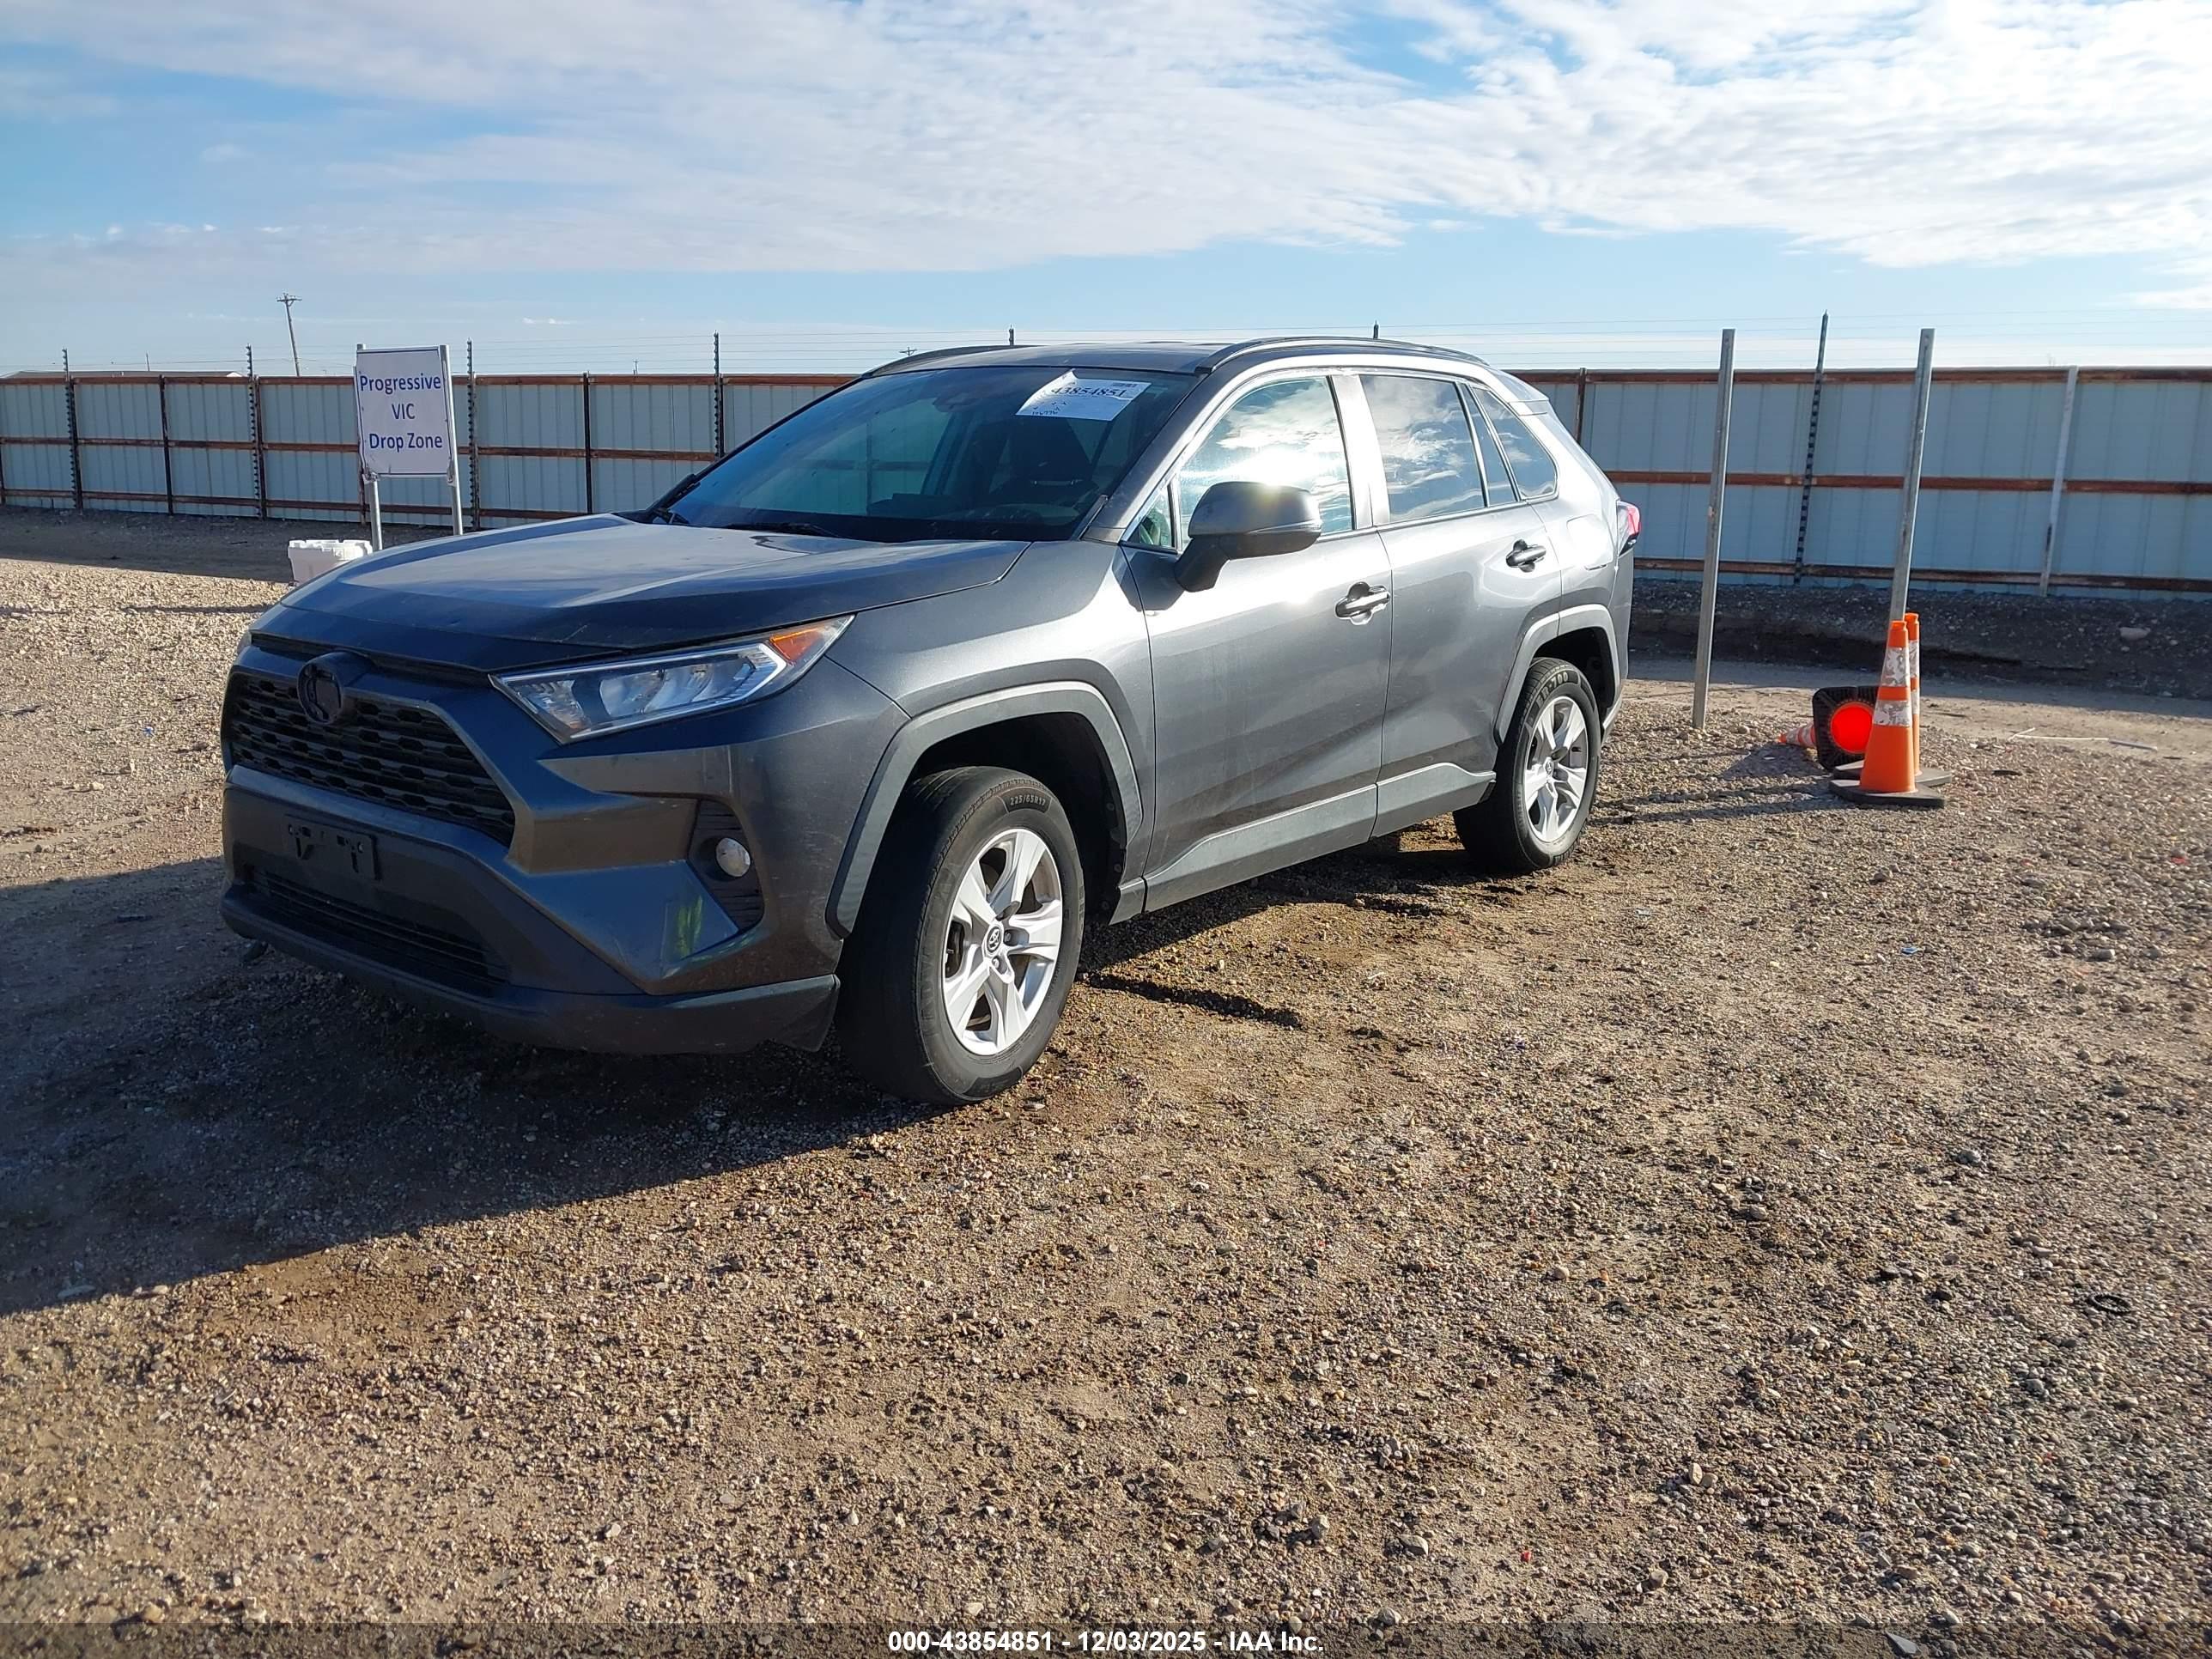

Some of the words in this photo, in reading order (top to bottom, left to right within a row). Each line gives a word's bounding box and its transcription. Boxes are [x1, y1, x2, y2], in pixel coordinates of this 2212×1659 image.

[360, 372, 441, 395] Progressive
[1050, 386, 1127, 398] 43854851
[392, 403, 416, 420] VIC
[369, 433, 404, 453] Drop
[408, 432, 443, 449] Zone
[1010, 793, 1046, 806] 225/65R17
